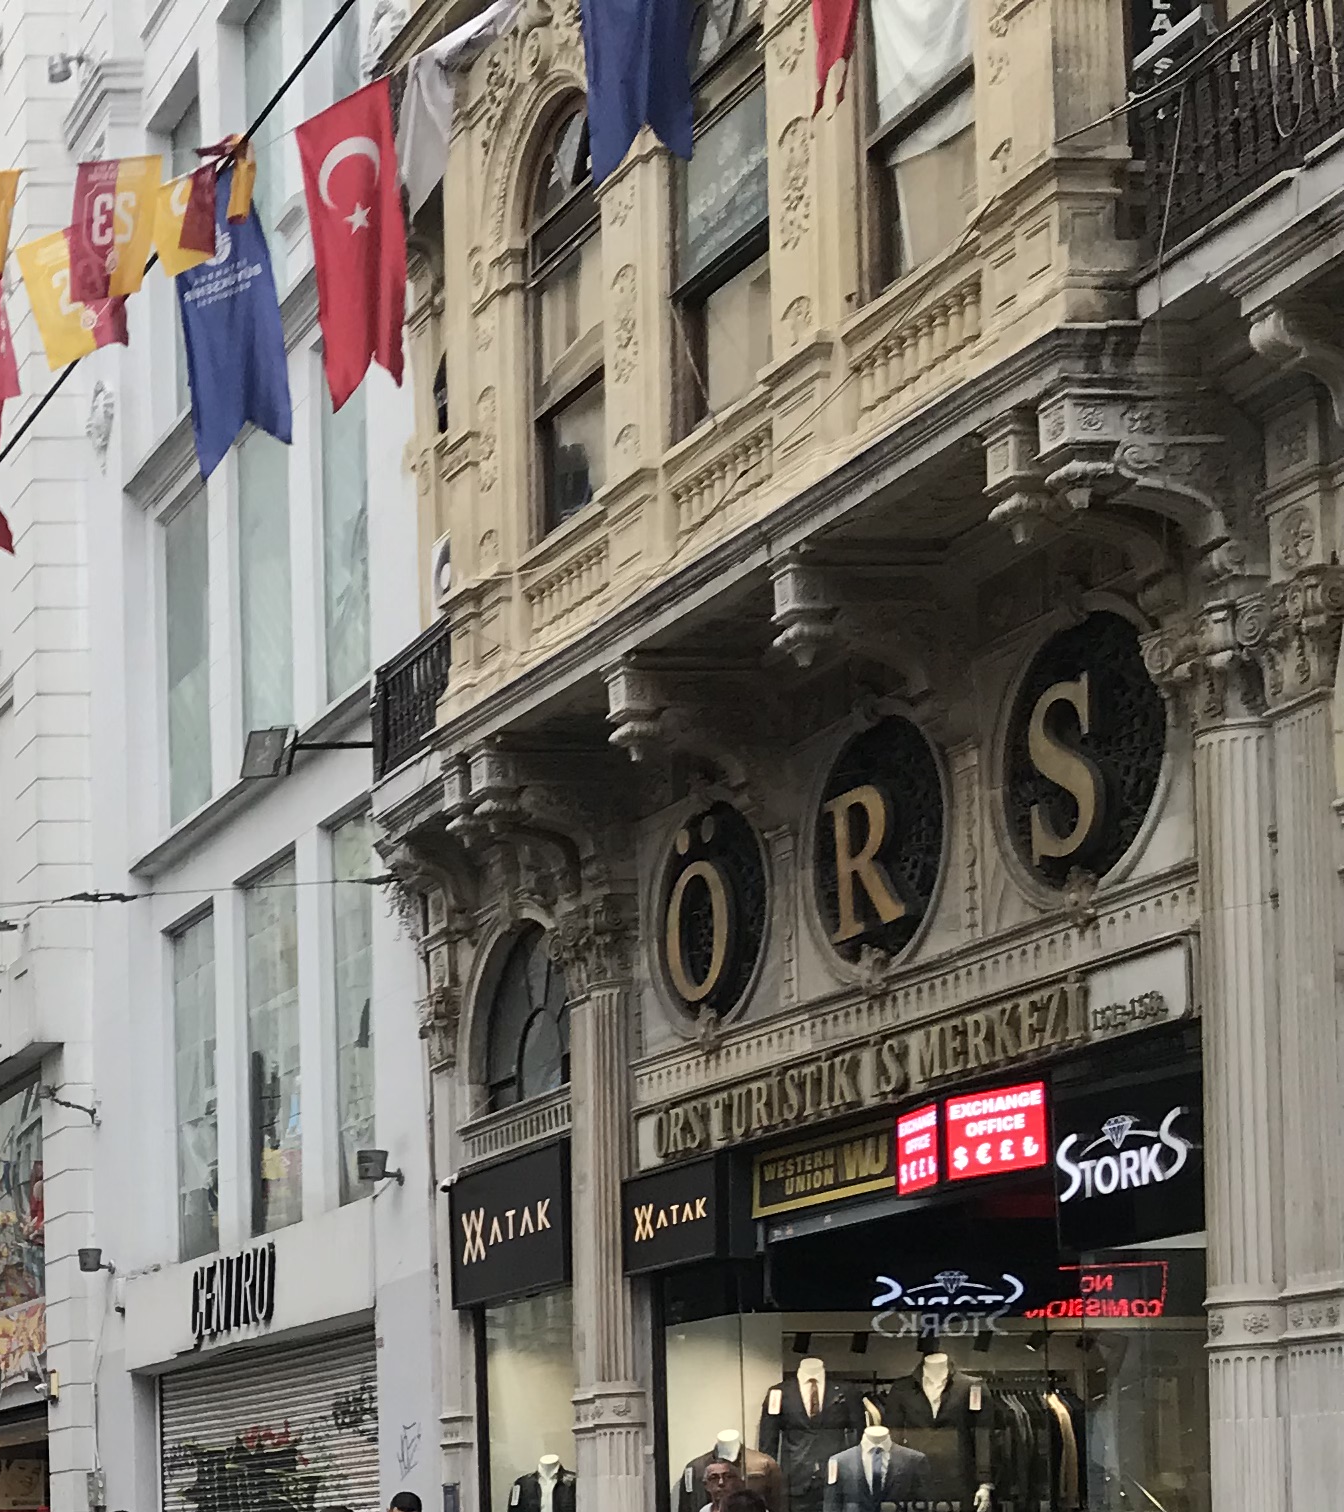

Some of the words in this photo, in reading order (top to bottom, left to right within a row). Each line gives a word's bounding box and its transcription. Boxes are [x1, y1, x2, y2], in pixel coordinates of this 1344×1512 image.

[948, 1088, 1042, 1121] EXCHANGE
[965, 1113, 1026, 1138] OFFICE
[763, 1149, 835, 1182] WESTERN
[1055, 1106, 1188, 1203] STORKS
[784, 1167, 835, 1196] UNION
[192, 1242, 276, 1338] CENTRO
